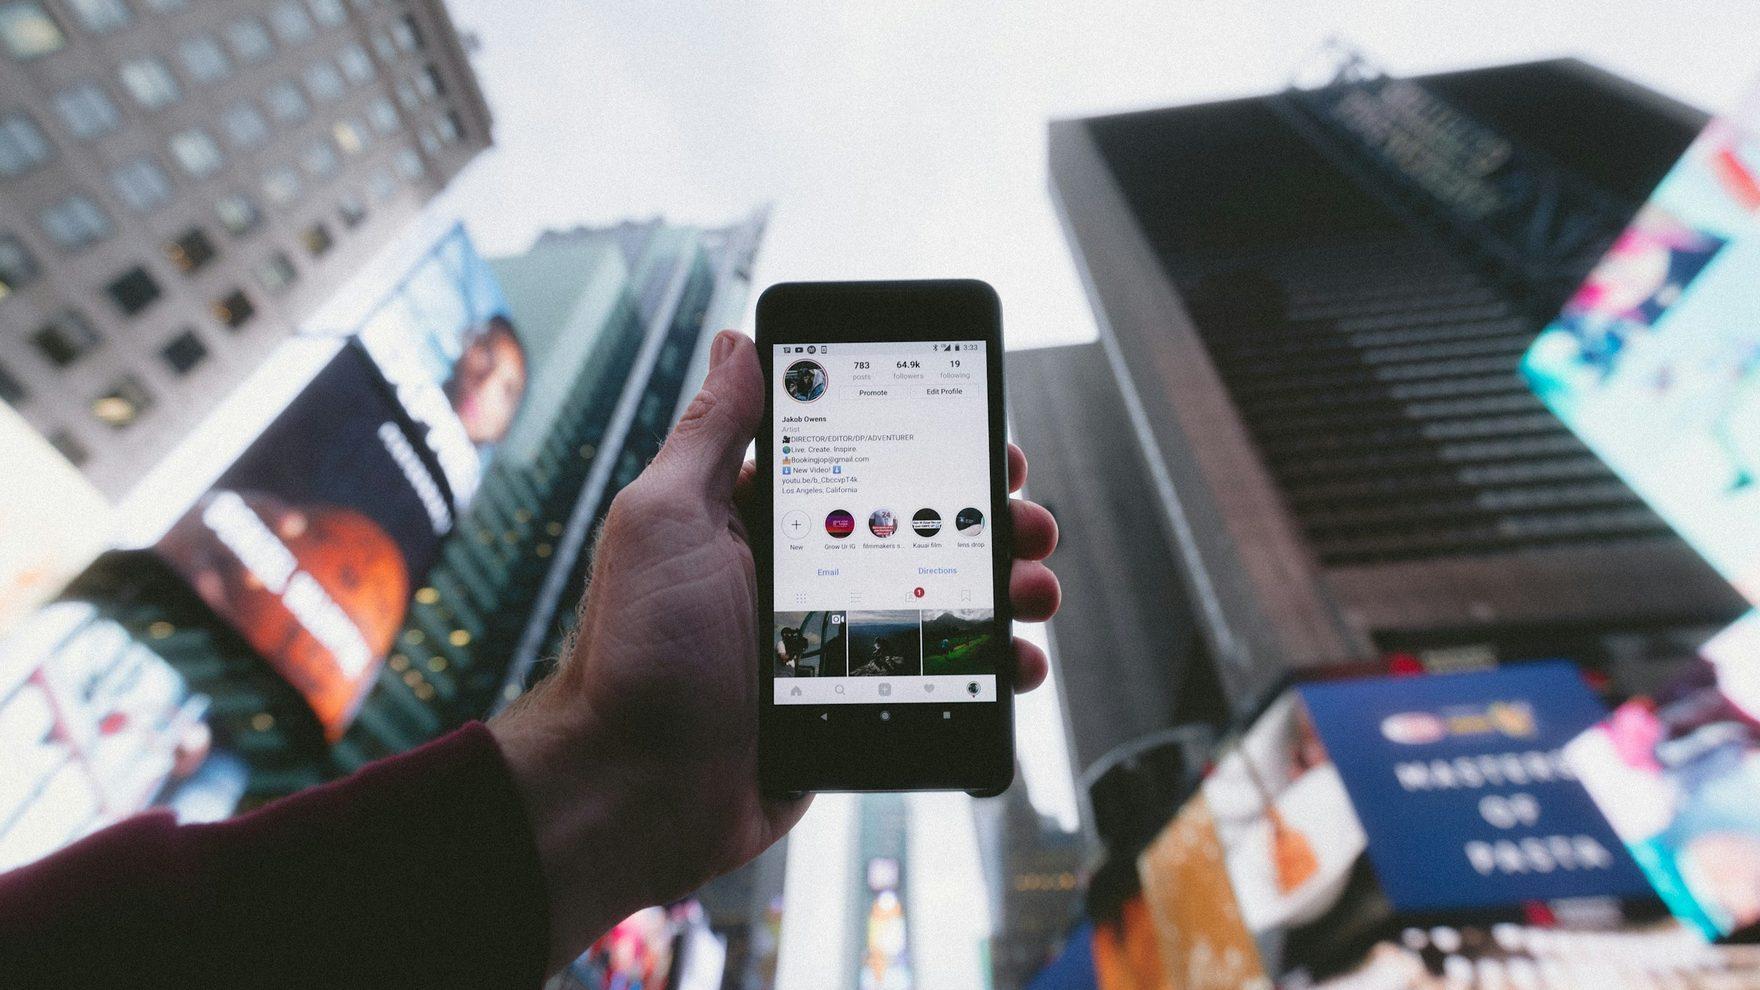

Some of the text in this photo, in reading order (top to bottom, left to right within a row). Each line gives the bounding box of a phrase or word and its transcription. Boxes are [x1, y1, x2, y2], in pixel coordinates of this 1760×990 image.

[853, 361, 870, 370] 783
[896, 360, 921, 369] 64.9k
[950, 360, 961, 368] 19
[893, 372, 924, 380] followers
[940, 372, 970, 380] following
[926, 387, 963, 396] Edit Profile
[803, 415, 827, 423] Owens
[833, 445, 857, 454] Inspire
[970, 541, 985, 549] drop
[817, 568, 839, 576] Email
[917, 567, 958, 575] Directions
